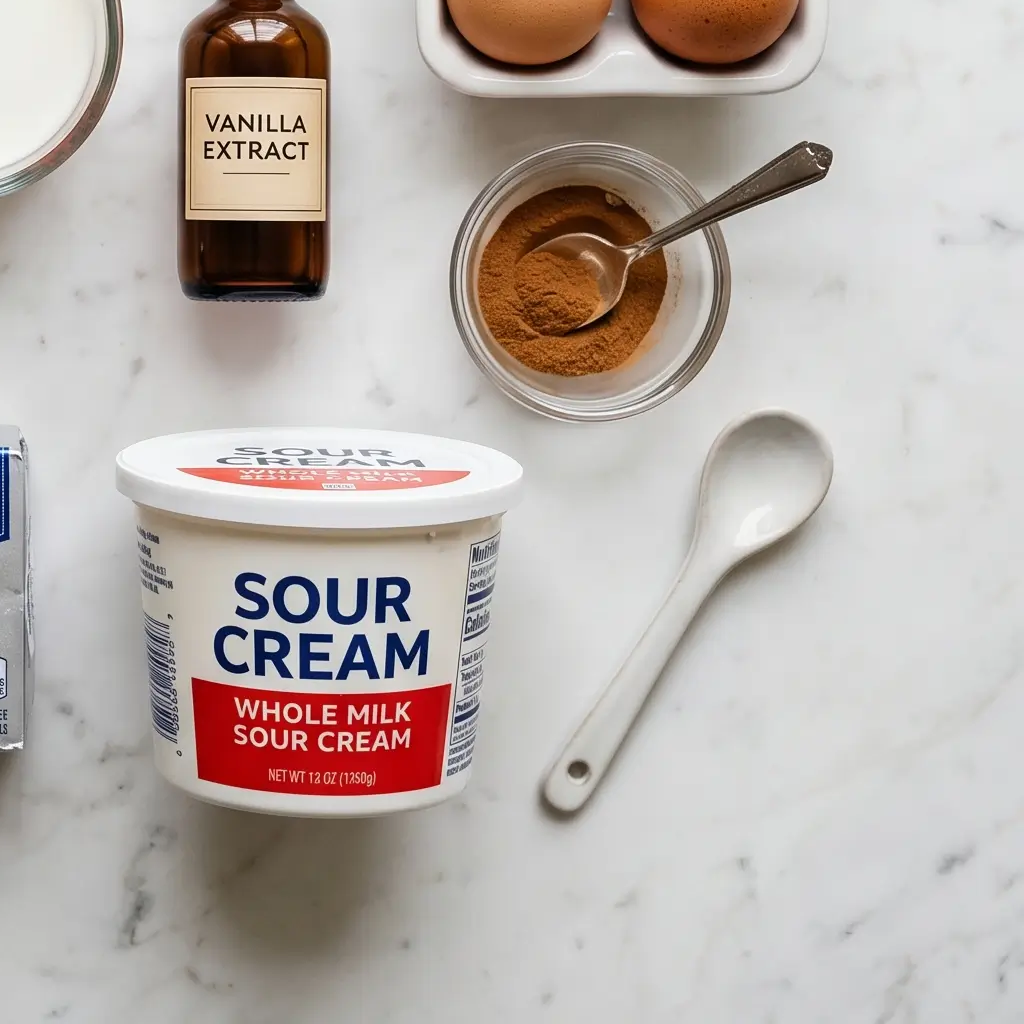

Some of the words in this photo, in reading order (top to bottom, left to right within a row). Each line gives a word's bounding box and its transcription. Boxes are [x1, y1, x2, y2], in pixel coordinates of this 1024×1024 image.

[205, 114, 307, 133] VANILLA
[203, 141, 309, 160] EXTRACT
[216, 456, 426, 467] CREAM
[233, 447, 396, 457] SOUR
[234, 572, 412, 625] SOUR
[213, 625, 430, 681] CREAM
[234, 697, 338, 725] WHOLE
[347, 701, 412, 725] MILK
[233, 724, 309, 752] SOUR
[317, 728, 411, 752] CREAM
[268, 768, 287, 782] NET
[289, 770, 306, 784] WT
